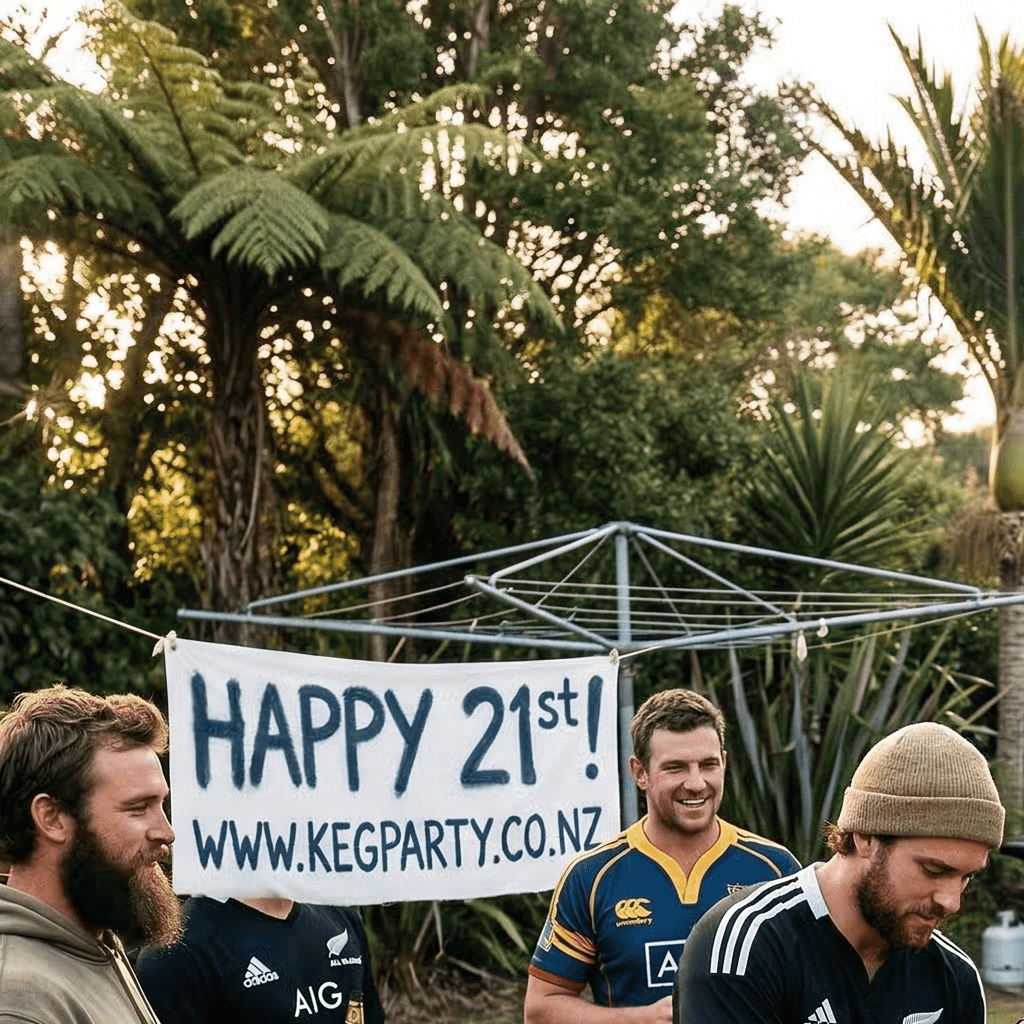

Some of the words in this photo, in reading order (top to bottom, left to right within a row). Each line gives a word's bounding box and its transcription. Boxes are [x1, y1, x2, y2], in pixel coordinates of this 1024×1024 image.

[190, 669, 434, 798] HAPPY
[460, 675, 604, 786] 21st!
[193, 806, 602, 873] WWW.KEGPARTY.CO.NZ
[294, 981, 343, 1017] AIG
